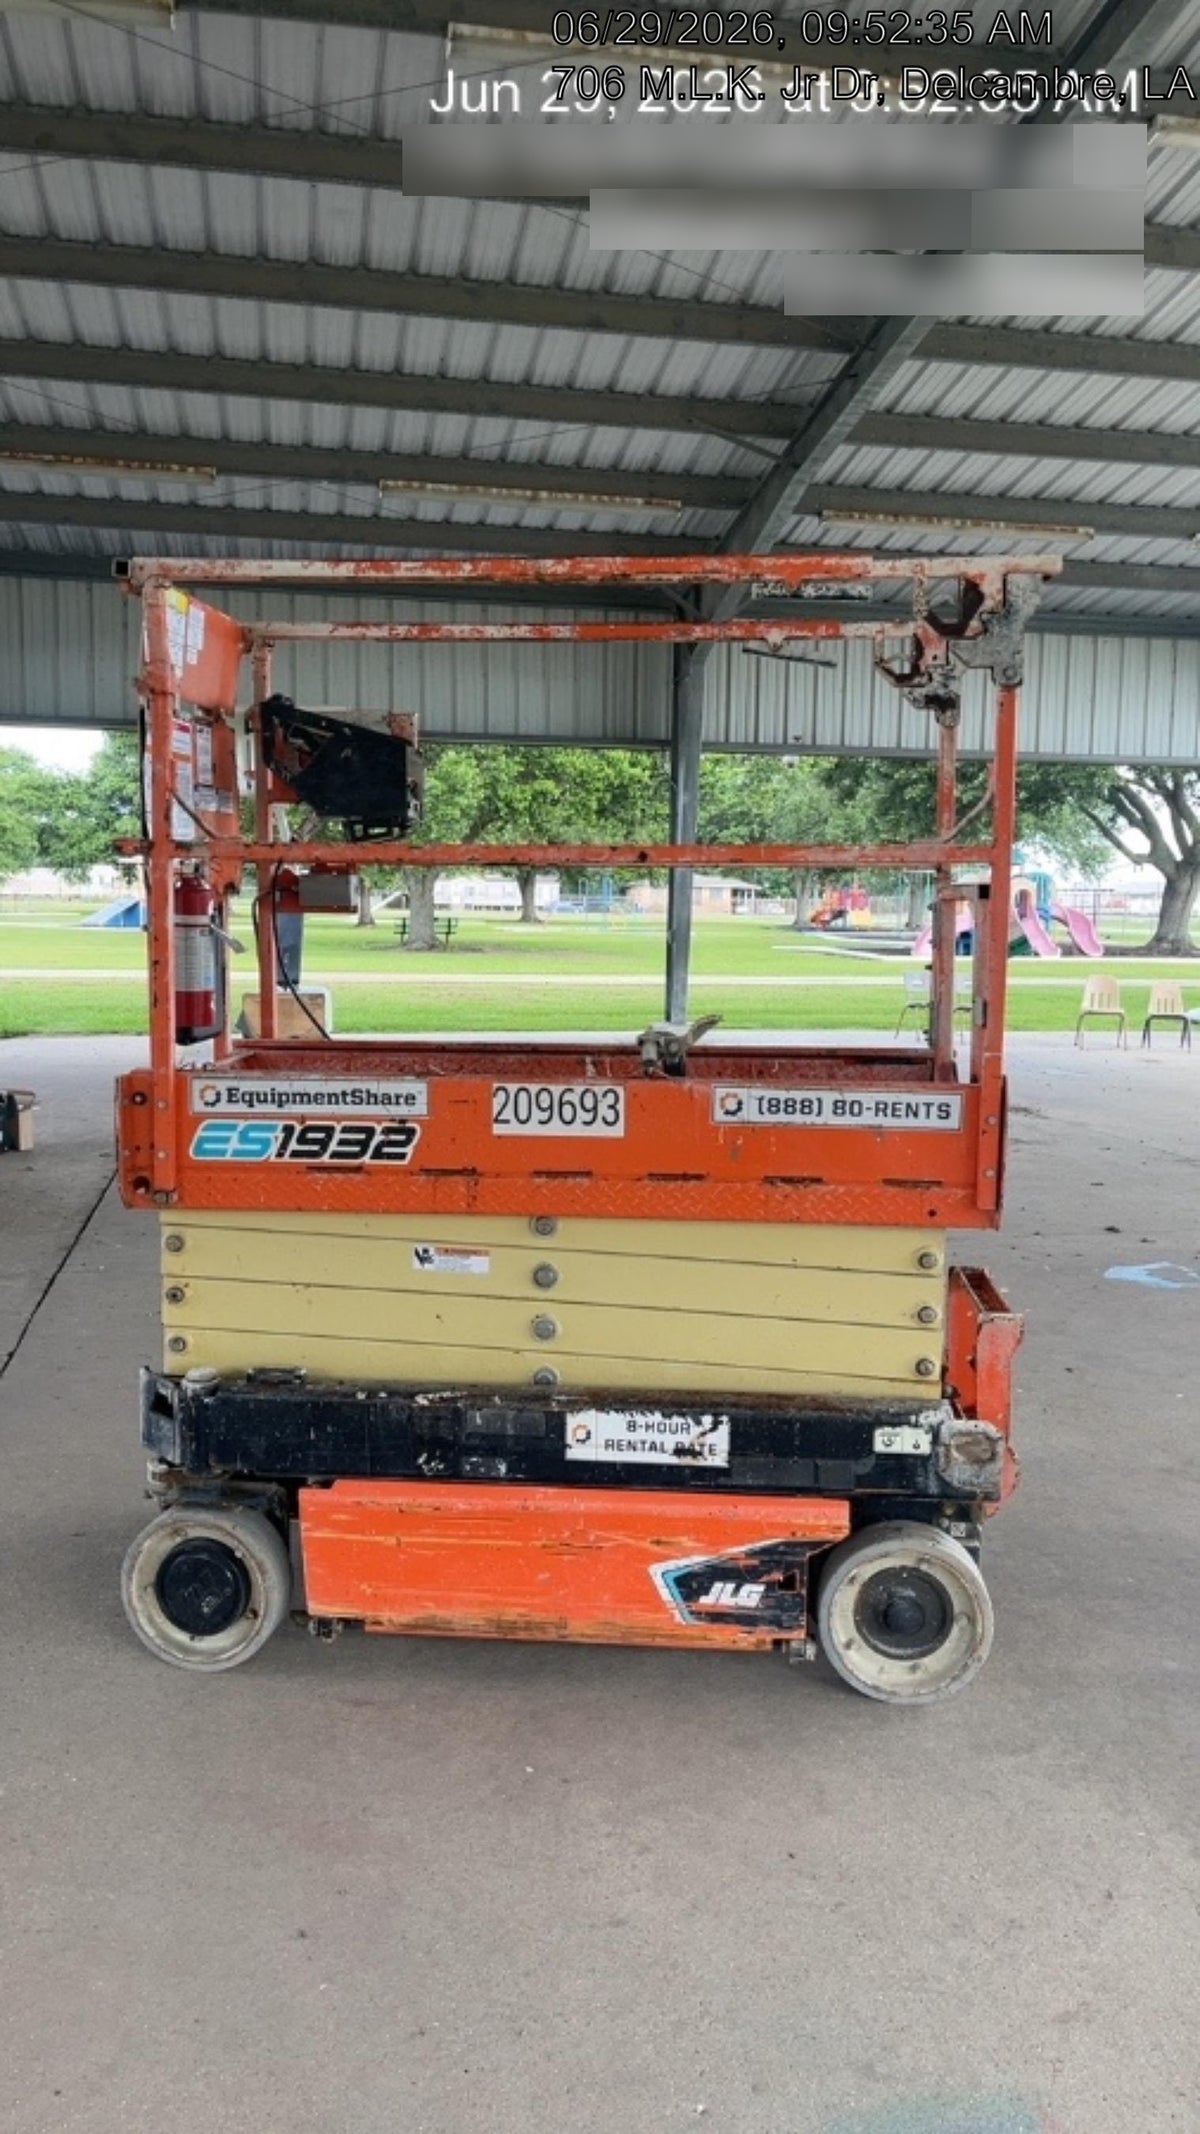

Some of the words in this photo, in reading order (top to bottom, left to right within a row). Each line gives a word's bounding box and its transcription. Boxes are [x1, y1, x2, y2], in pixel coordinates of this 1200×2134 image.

[225, 1086, 417, 1108] EquipmentShare
[492, 1085, 621, 1127] 209693
[757, 1095, 823, 1117] (888)
[831, 1098, 952, 1121] 80-RENTS
[191, 1120, 419, 1162] ES1932
[625, 1419, 692, 1436] 8-HOUR
[604, 1438, 667, 1455] RENTAL
[699, 1581, 766, 1608] JLG
